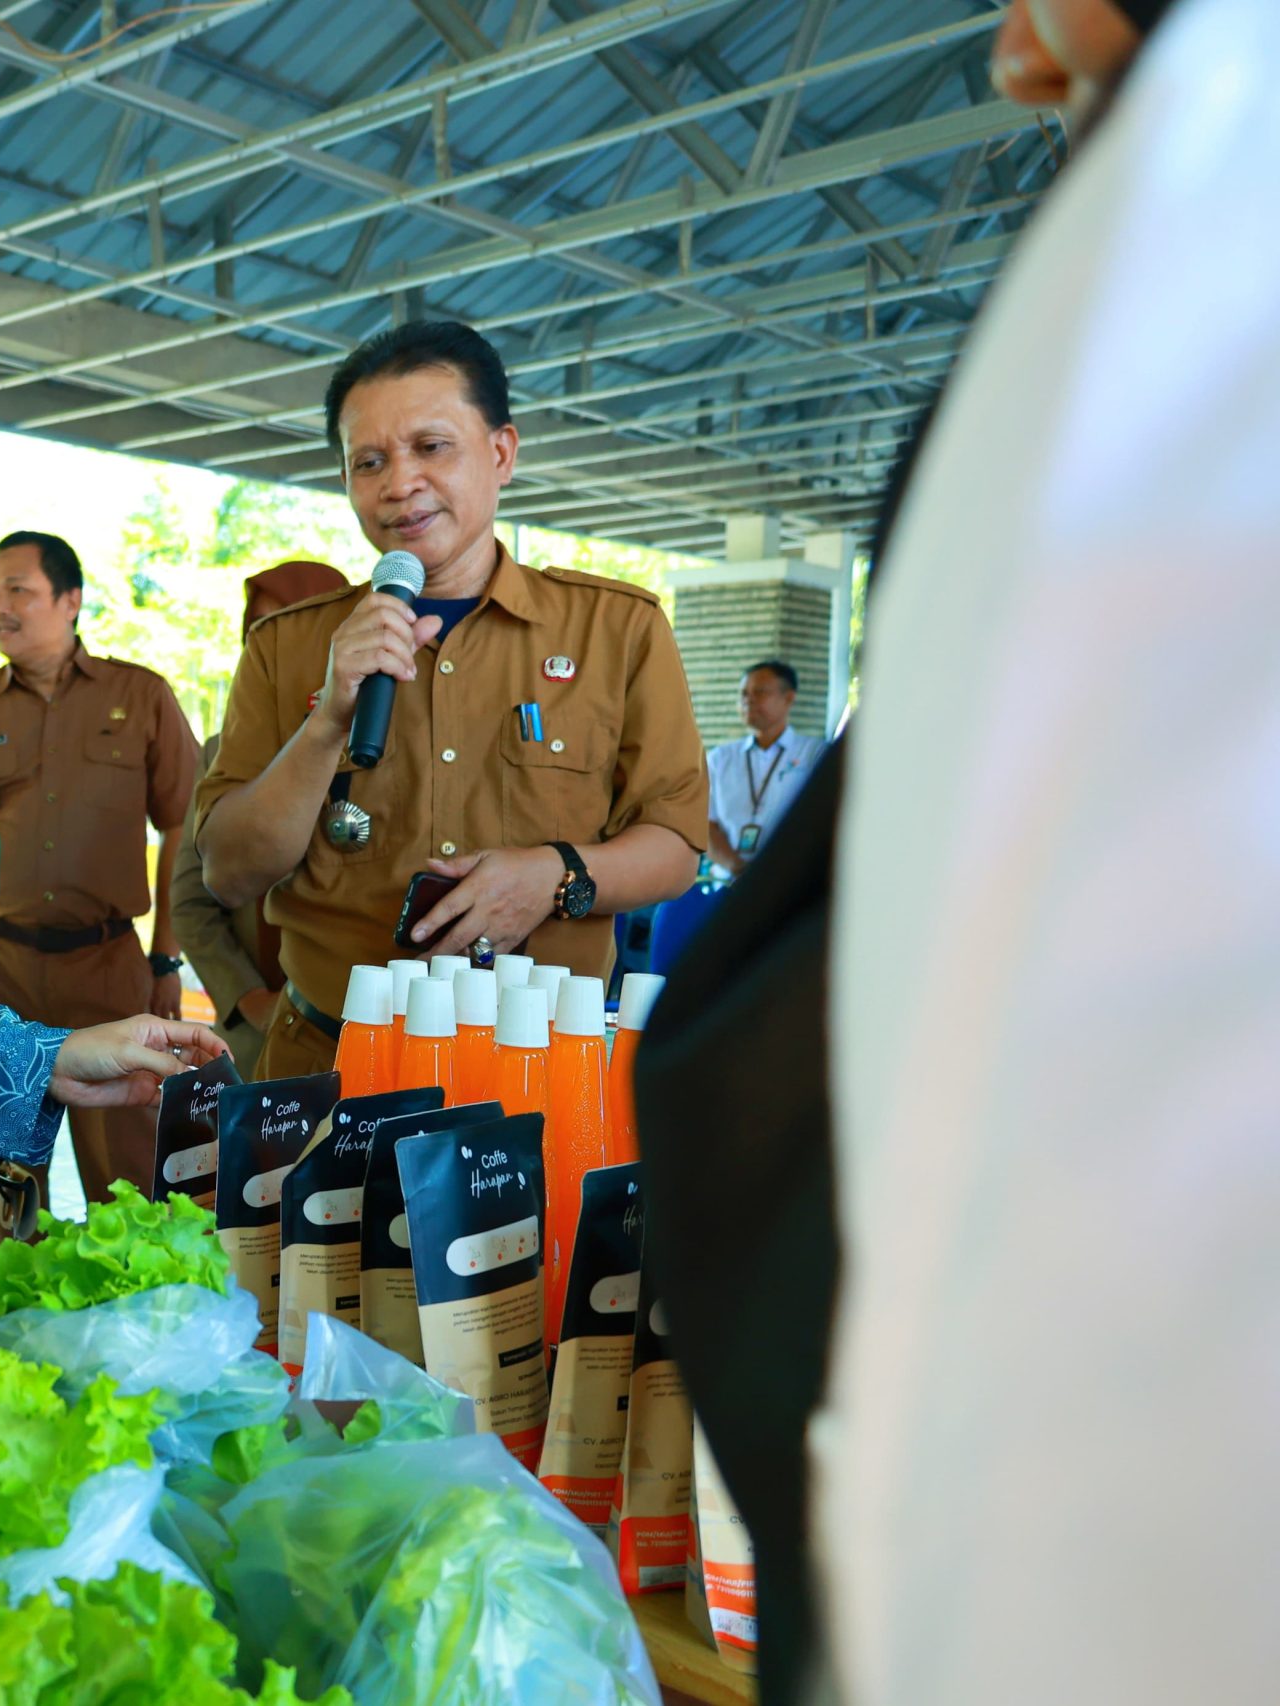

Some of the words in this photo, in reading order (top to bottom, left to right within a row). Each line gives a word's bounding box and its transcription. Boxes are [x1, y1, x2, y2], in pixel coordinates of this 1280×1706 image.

[276, 1100, 300, 1116] Coffe
[261, 1115, 298, 1142] Harapan
[481, 1149, 508, 1169] Coffe
[470, 1167, 514, 1199] Harapan
